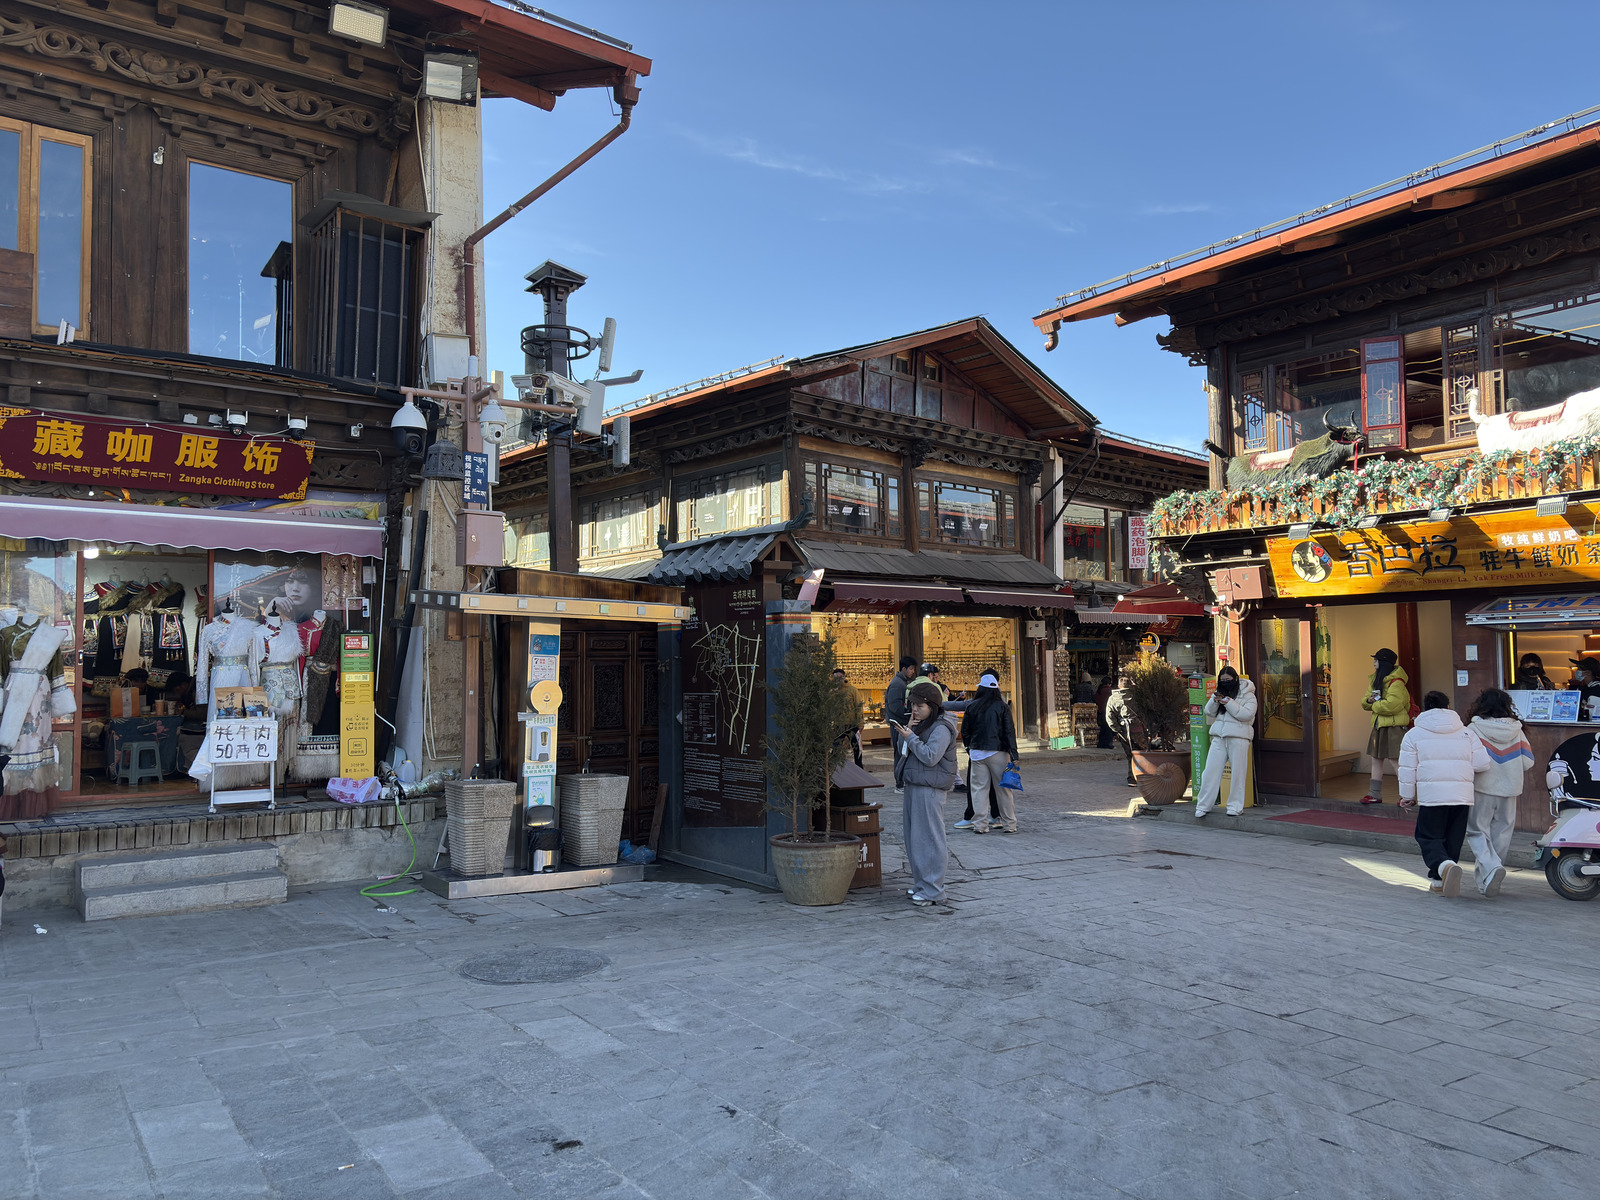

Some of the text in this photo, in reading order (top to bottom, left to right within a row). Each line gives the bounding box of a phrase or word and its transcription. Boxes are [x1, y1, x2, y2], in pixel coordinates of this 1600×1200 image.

[32, 420, 282, 475] 藏咖服饰
[179, 474, 212, 485] Zangka
[463, 455, 472, 500] 视频监控区域
[1131, 517, 1146, 557] 藏药泡脚
[1501, 529, 1578, 546] 牧纯鲜奶吧
[1339, 535, 1600, 579] 香巴拉 牦牛鲜奶茶
[1491, 573, 1515, 581] Fresh
[213, 725, 270, 741] 牦牛肉
[215, 743, 270, 759] 50两包
